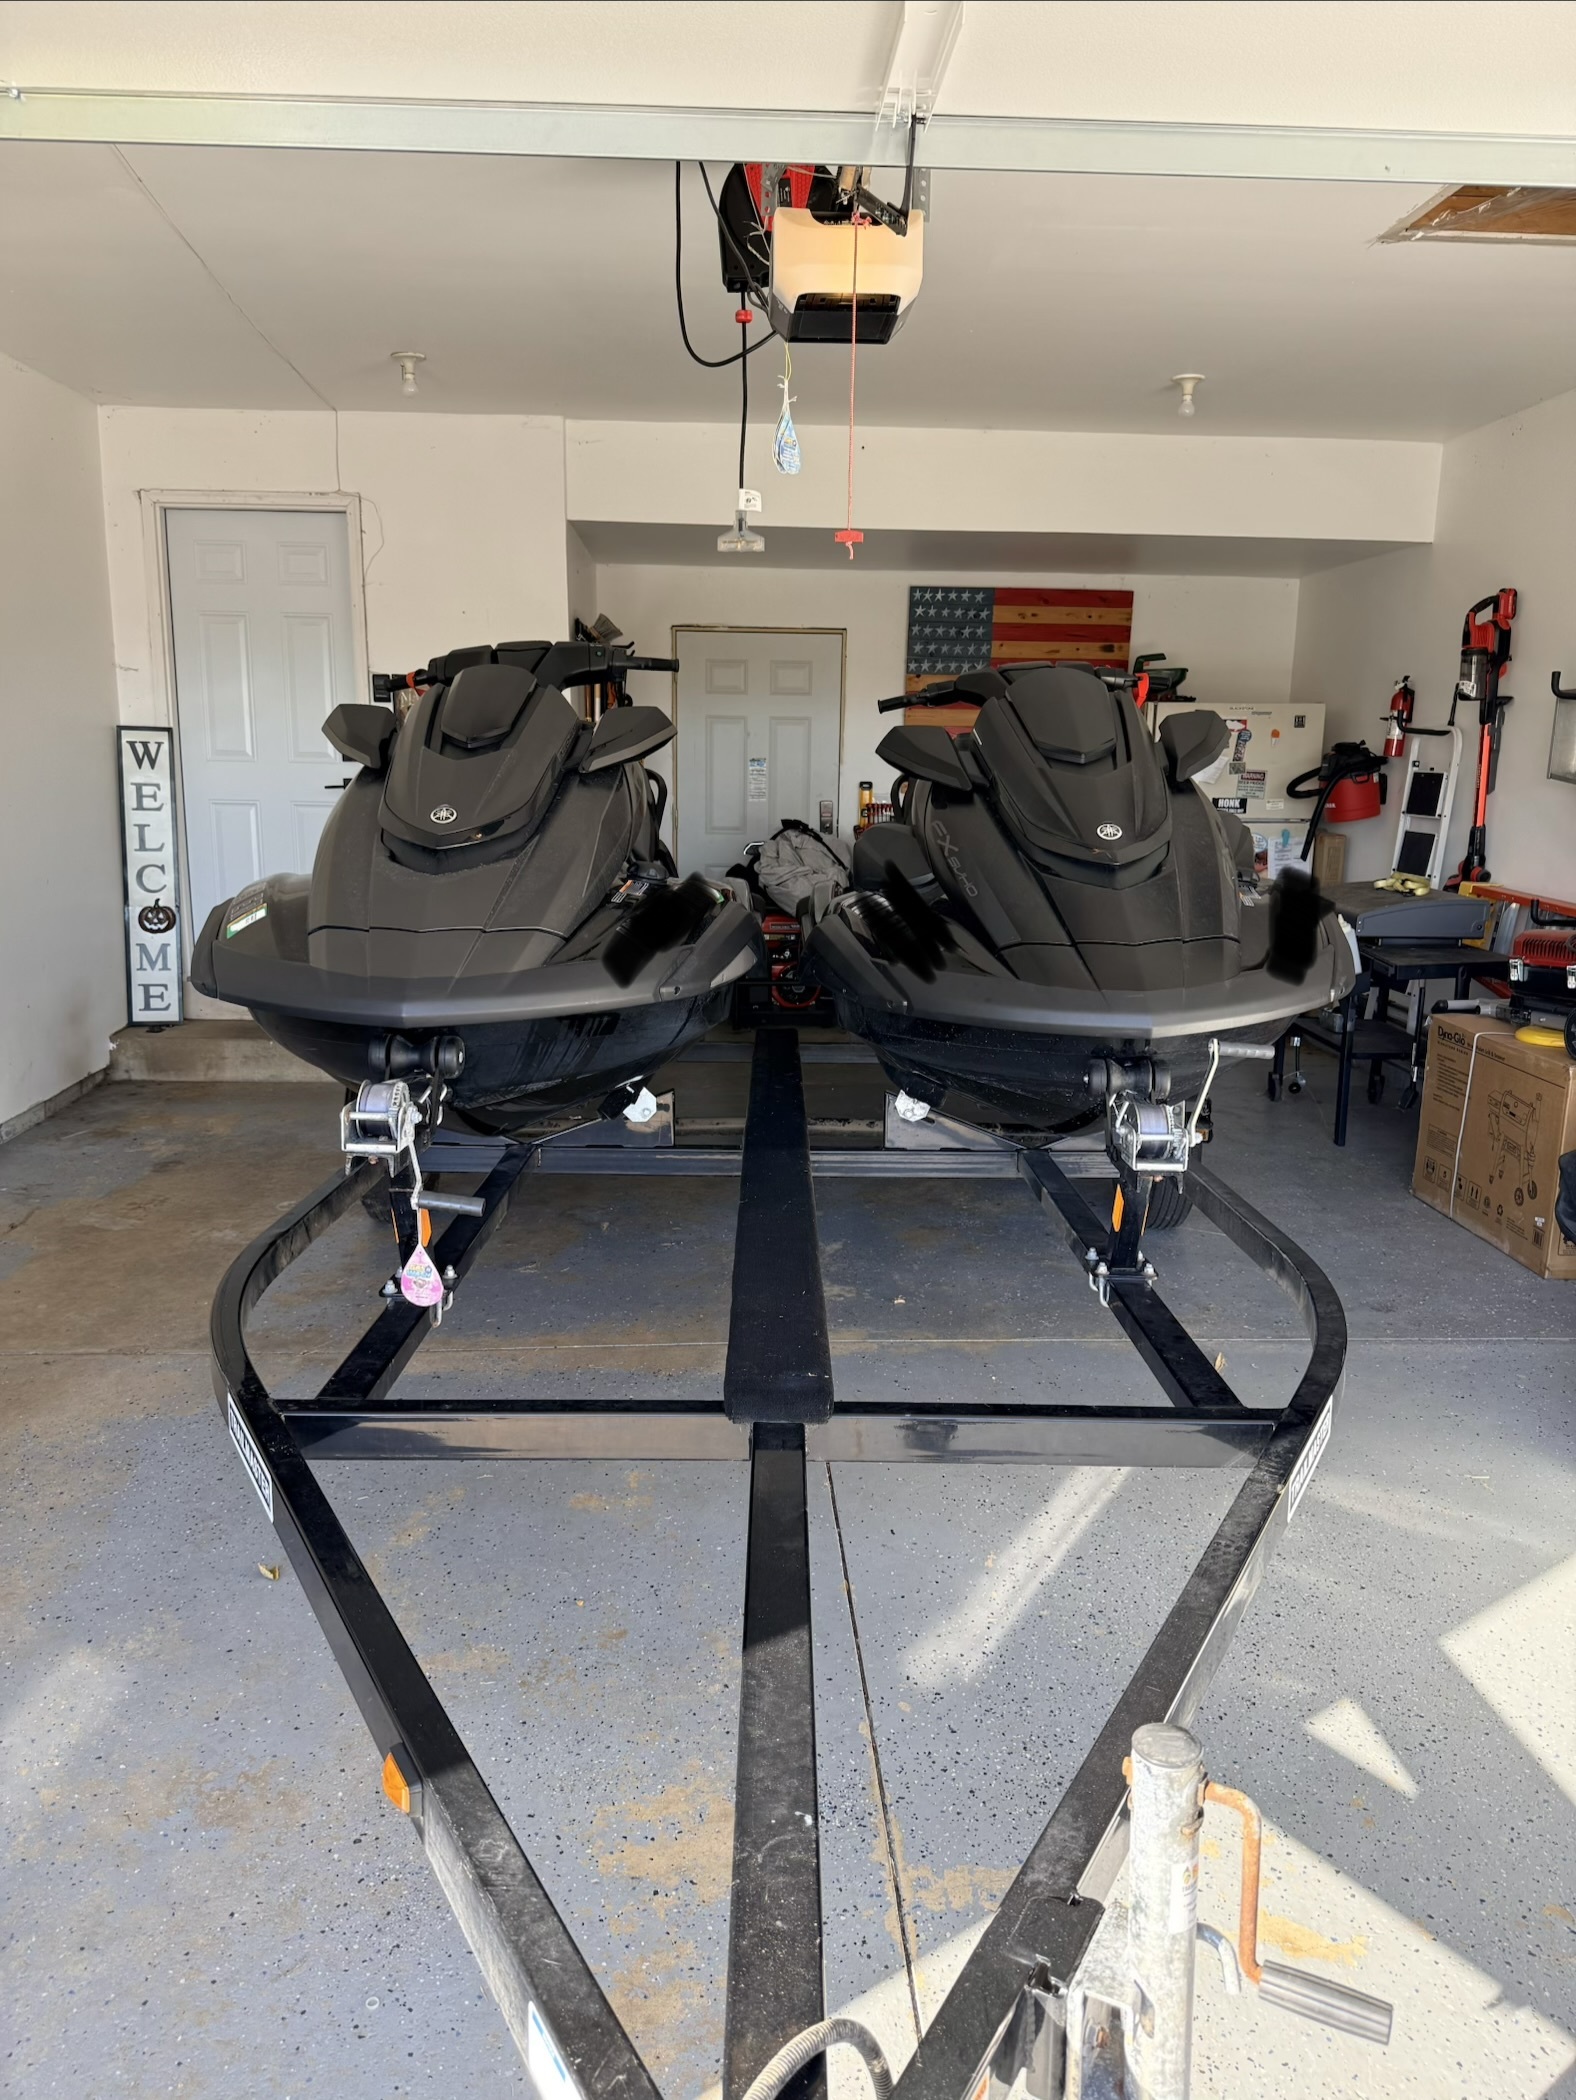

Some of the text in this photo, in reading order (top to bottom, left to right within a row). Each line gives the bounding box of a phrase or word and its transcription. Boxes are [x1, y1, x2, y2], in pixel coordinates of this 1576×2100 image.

[1218, 799, 1241, 808] HONK
[931, 820, 978, 897] FX SVHO
